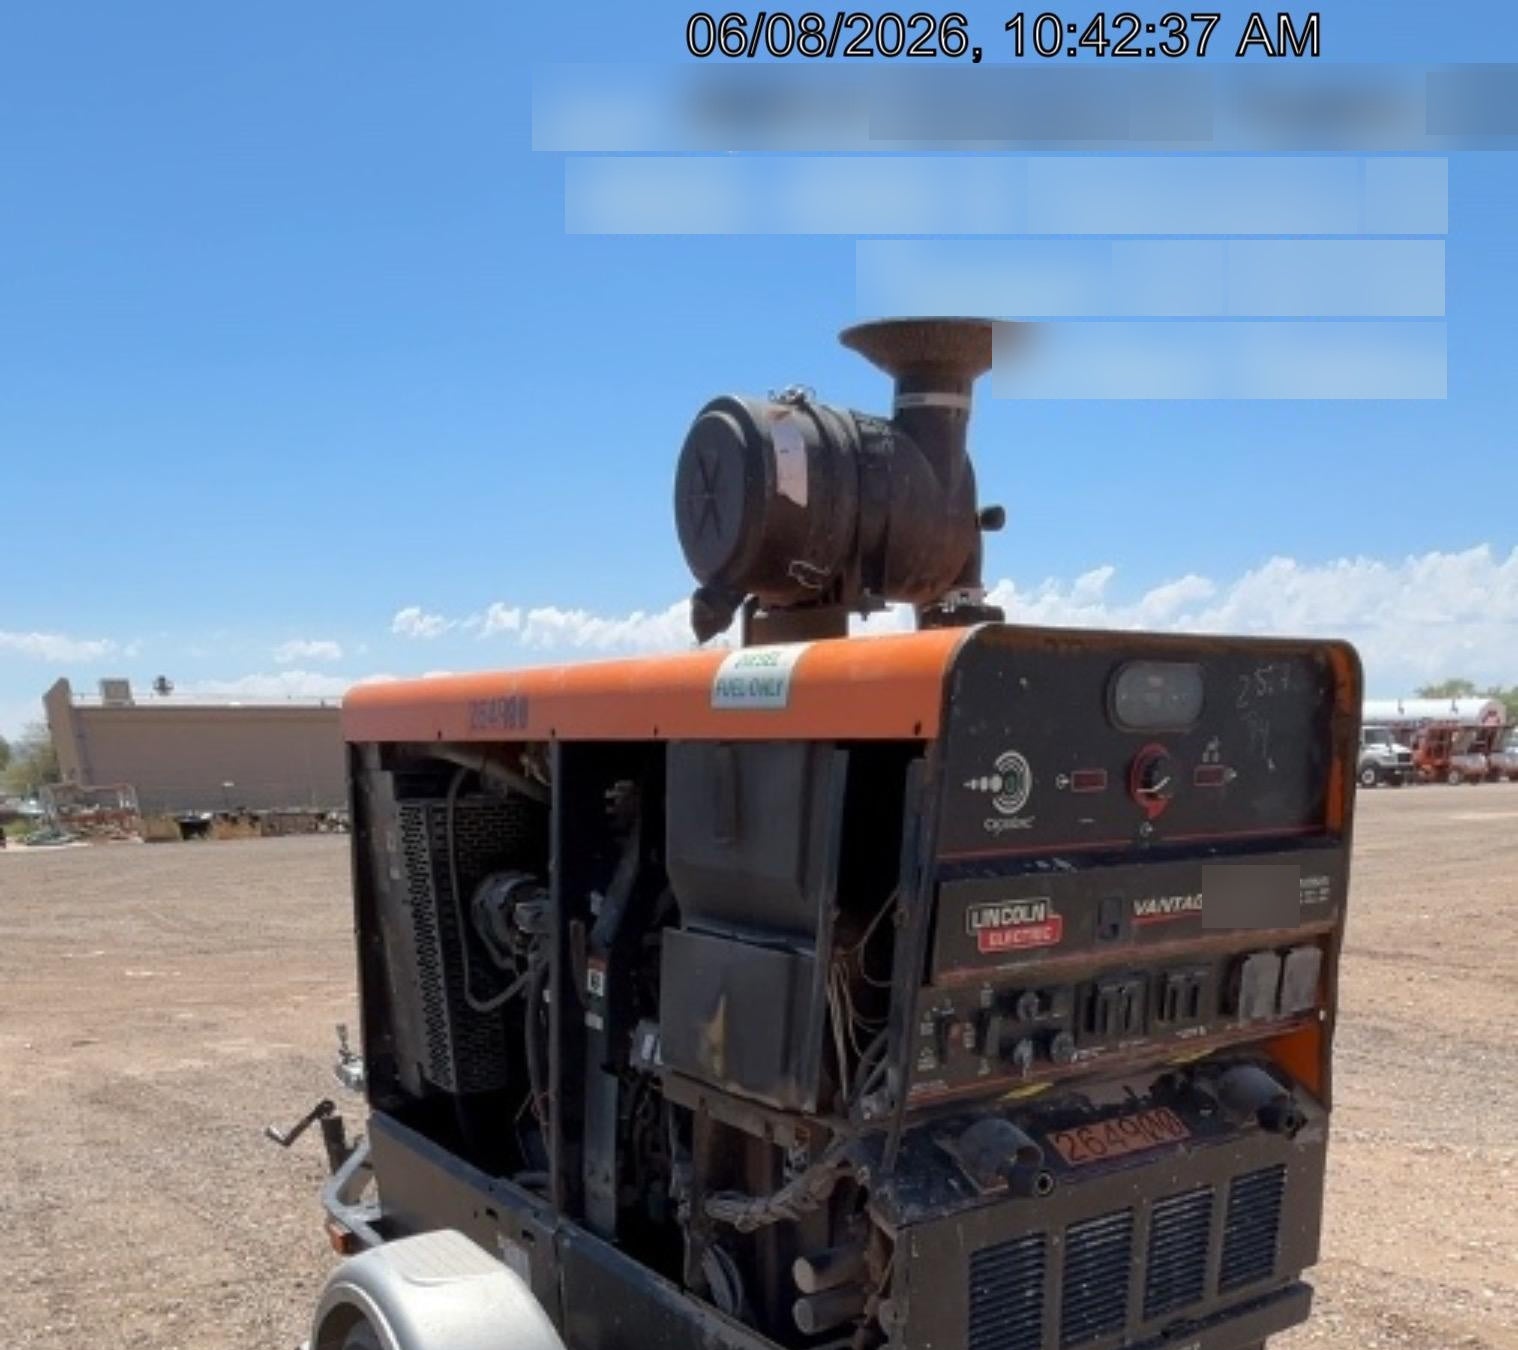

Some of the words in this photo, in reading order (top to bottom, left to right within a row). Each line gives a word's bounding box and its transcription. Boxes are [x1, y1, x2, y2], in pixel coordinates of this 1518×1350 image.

[971, 903, 1045, 928] LINCOLN
[1133, 894, 1202, 916] VANTAG
[988, 926, 1054, 946] ELECTRIC
